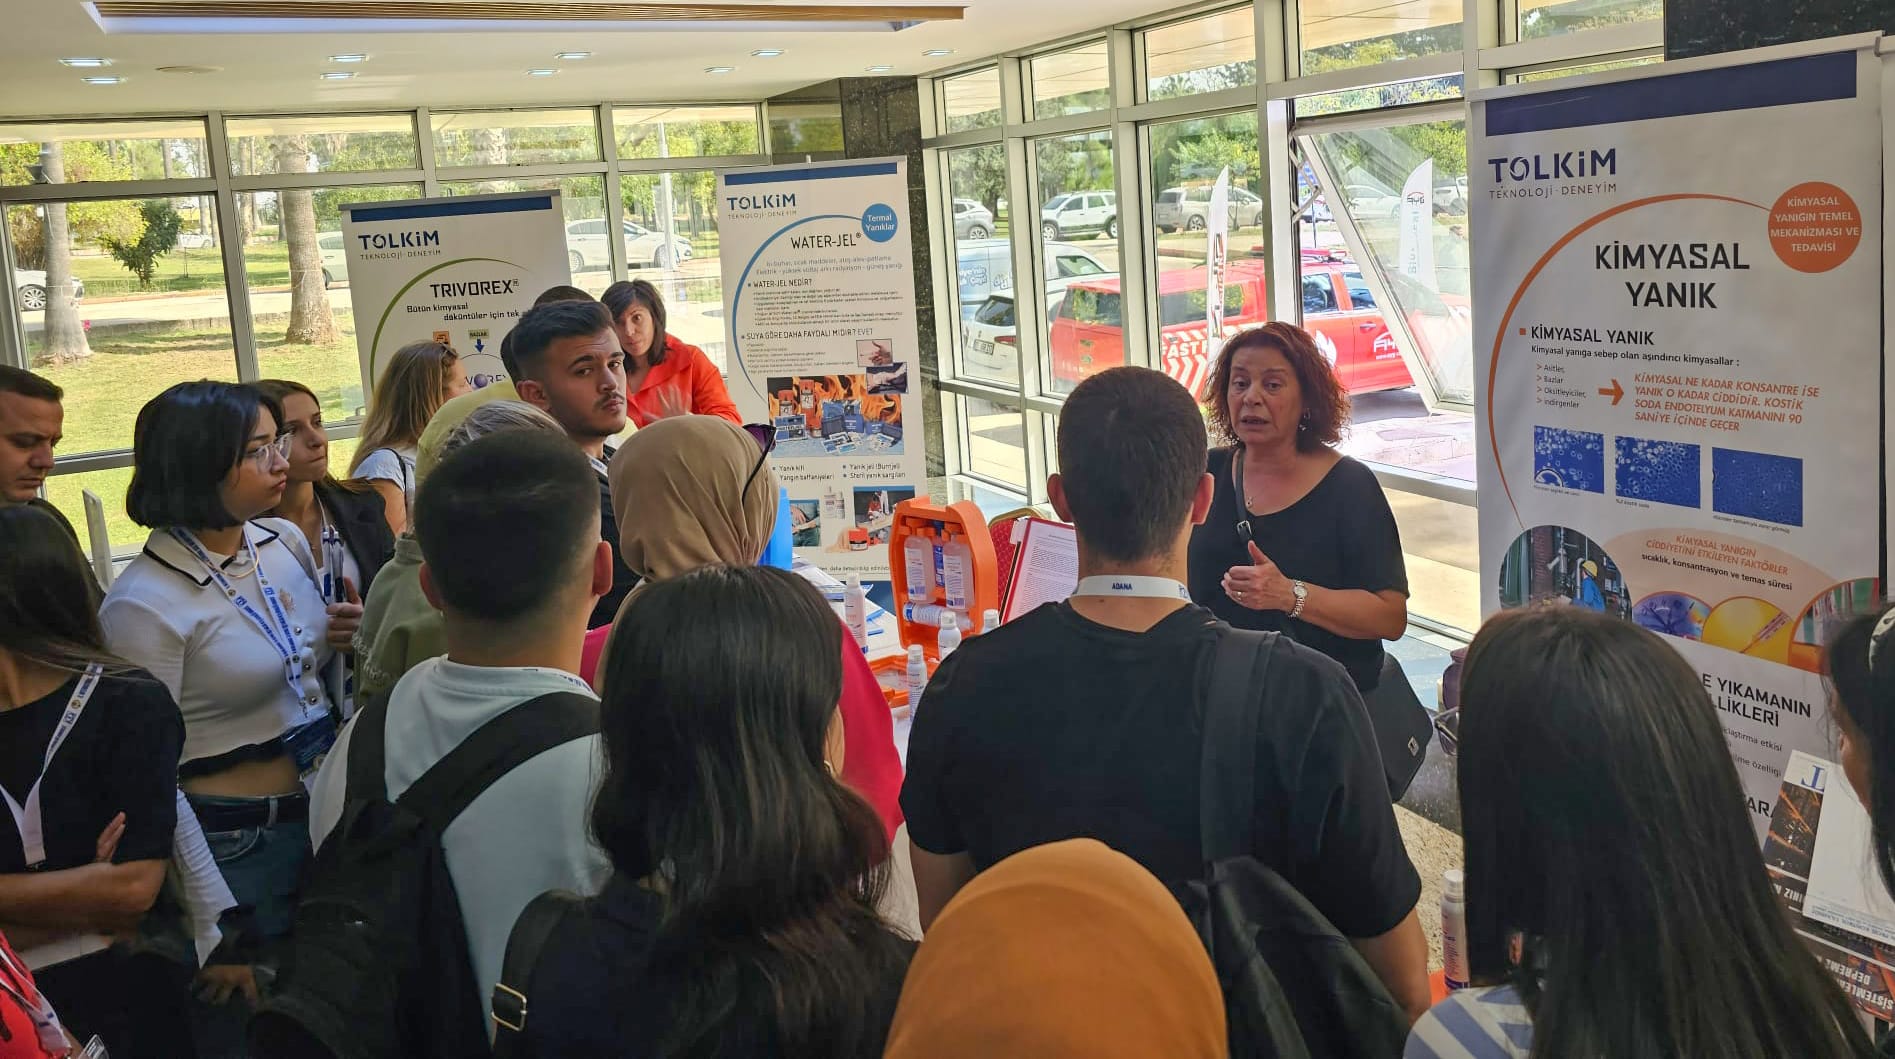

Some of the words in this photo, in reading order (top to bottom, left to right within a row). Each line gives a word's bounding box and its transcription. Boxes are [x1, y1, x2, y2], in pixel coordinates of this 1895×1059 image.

[1561, 181, 1617, 195] DENEYİM
[1787, 196, 1841, 207] KİMYASAL
[867, 212, 892, 222] Termal
[1819, 211, 1854, 221] TEMEL
[865, 222, 894, 232] Yanıklar
[1770, 226, 1842, 237] MEKANİZMASI
[1845, 226, 1860, 236] VE
[1595, 240, 1750, 270] KİMYASAL
[1625, 281, 1717, 309] YANIK
[407, 304, 431, 313] Bütün
[433, 302, 468, 312] kimyasal
[489, 310, 505, 320] için
[507, 309, 520, 318] tek
[783, 330, 802, 338] DAHA
[1531, 323, 1602, 343] KİMYASAL
[1606, 329, 1655, 346] YANIK
[1531, 344, 1564, 356] Kimyasal
[1594, 350, 1618, 360] sebep
[1620, 351, 1640, 360] olan
[1642, 352, 1681, 363] aşındırıcı
[1683, 353, 1734, 367] kimyasallar
[1634, 371, 1682, 386] KİMYASAL
[1685, 377, 1699, 387] NE
[1701, 378, 1733, 390] KADAR
[1735, 381, 1799, 396] KONSANTRE
[1801, 384, 1820, 398] İSE
[1635, 386, 1663, 397] YANIK
[1666, 388, 1675, 398] O
[1677, 389, 1710, 401] KADAR
[1764, 397, 1804, 410] KOSTİK
[1634, 399, 1662, 410] SODA
[1664, 401, 1726, 416] ENDOTELYUM
[1728, 407, 1785, 423] KATMANINI
[1788, 413, 1802, 424] 90
[1634, 411, 1671, 424] SANİYE
[1673, 413, 1708, 428] İÇİNDE
[1710, 418, 1740, 432] GEÇER
[1675, 534, 1718, 550] KİMYASAL
[1641, 553, 1671, 565] sıcaklık,
[1671, 556, 1729, 577] konsantrasyon
[1730, 570, 1740, 579] ve
[1741, 573, 1766, 585] temas
[1767, 578, 1793, 591] süresi
[1697, 548, 1739, 565] ETKİLEYEN
[1739, 558, 1789, 576] FAKTÖRLER
[1112, 582, 1133, 590] ADANA
[1717, 676, 1811, 719] YIKAMANIN
[1712, 696, 1780, 728] LİKLERİ
[1760, 739, 1782, 752] etkisi
[1746, 796, 1777, 818] AR
